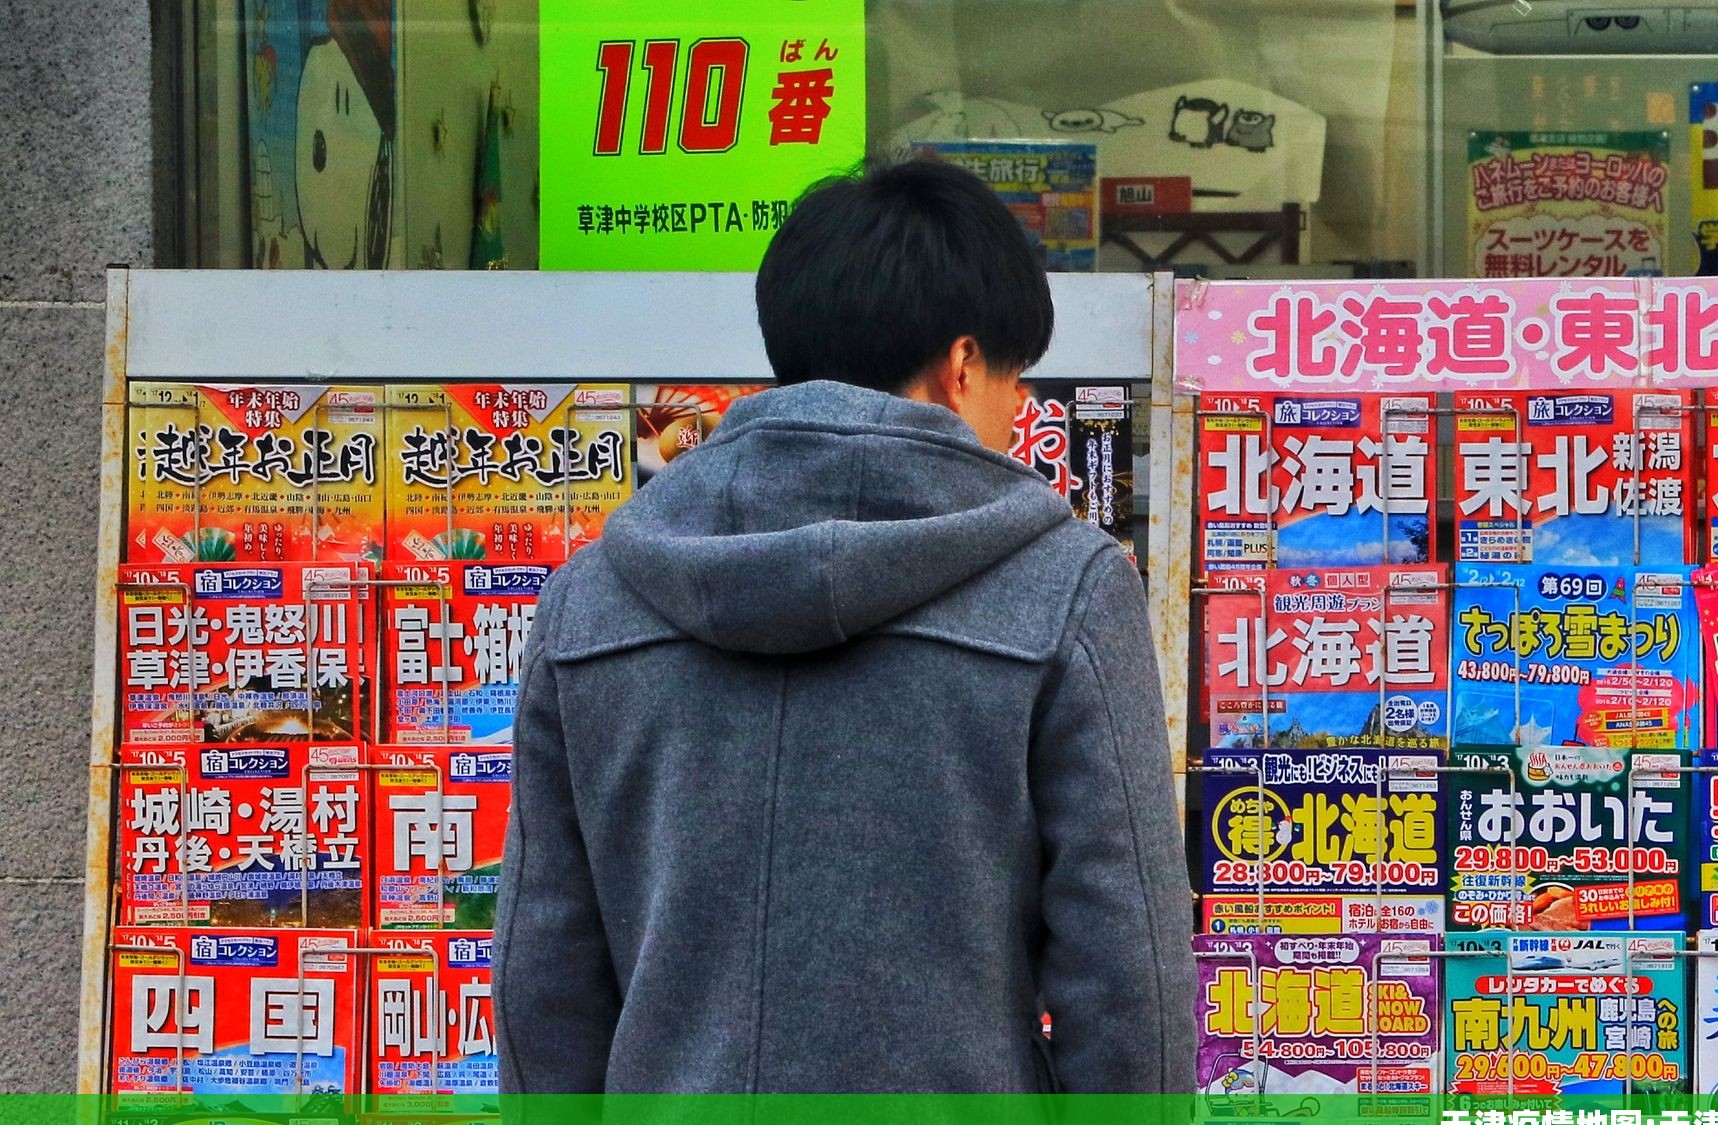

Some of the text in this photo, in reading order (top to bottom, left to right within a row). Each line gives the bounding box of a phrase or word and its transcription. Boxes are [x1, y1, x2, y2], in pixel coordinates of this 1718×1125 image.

[780, 39, 839, 62] ばん
[577, 202, 792, 234] 草津中学校区PTA・防犯
[1486, 228, 1649, 251] スーツケースを
[1485, 255, 1627, 276] 無料レンタル
[228, 391, 300, 410] 年末年始
[246, 411, 280, 428] 特集
[474, 391, 547, 410] 年末年始
[493, 411, 528, 428] 特集
[154, 426, 375, 487] 越年お正月
[402, 426, 624, 487] 越年お正月
[1613, 433, 1680, 471] 新潟
[1102, 433, 1113, 524] お正月におすすめの
[1207, 435, 1429, 516] 北海道
[1458, 436, 1608, 517] 東北
[1613, 477, 1683, 517] 佐渡
[1325, 573, 1370, 588] 個人型
[1541, 574, 1602, 597] 第69回
[1273, 593, 1383, 612] 観光周遊プラン
[127, 605, 346, 646] 日光・鬼怒川
[1458, 606, 1682, 660] さっぽろ雪まつり
[127, 649, 349, 689] 草津・伊香保
[1218, 616, 1436, 688] 北海道
[131, 786, 361, 836] 城崎・湯村
[1292, 793, 1438, 866] 北海道
[1459, 789, 1473, 842] おんせん県
[1478, 790, 1675, 844] おおいた
[132, 835, 361, 872] 丹後・天橋立
[1488, 977, 1641, 993] レンタカーでめぐる
[131, 975, 335, 1055] 四国
[1452, 997, 1597, 1052] 南九州
[1599, 998, 1656, 1022] 鹿児島
[1604, 1024, 1652, 1050] 宮崎
